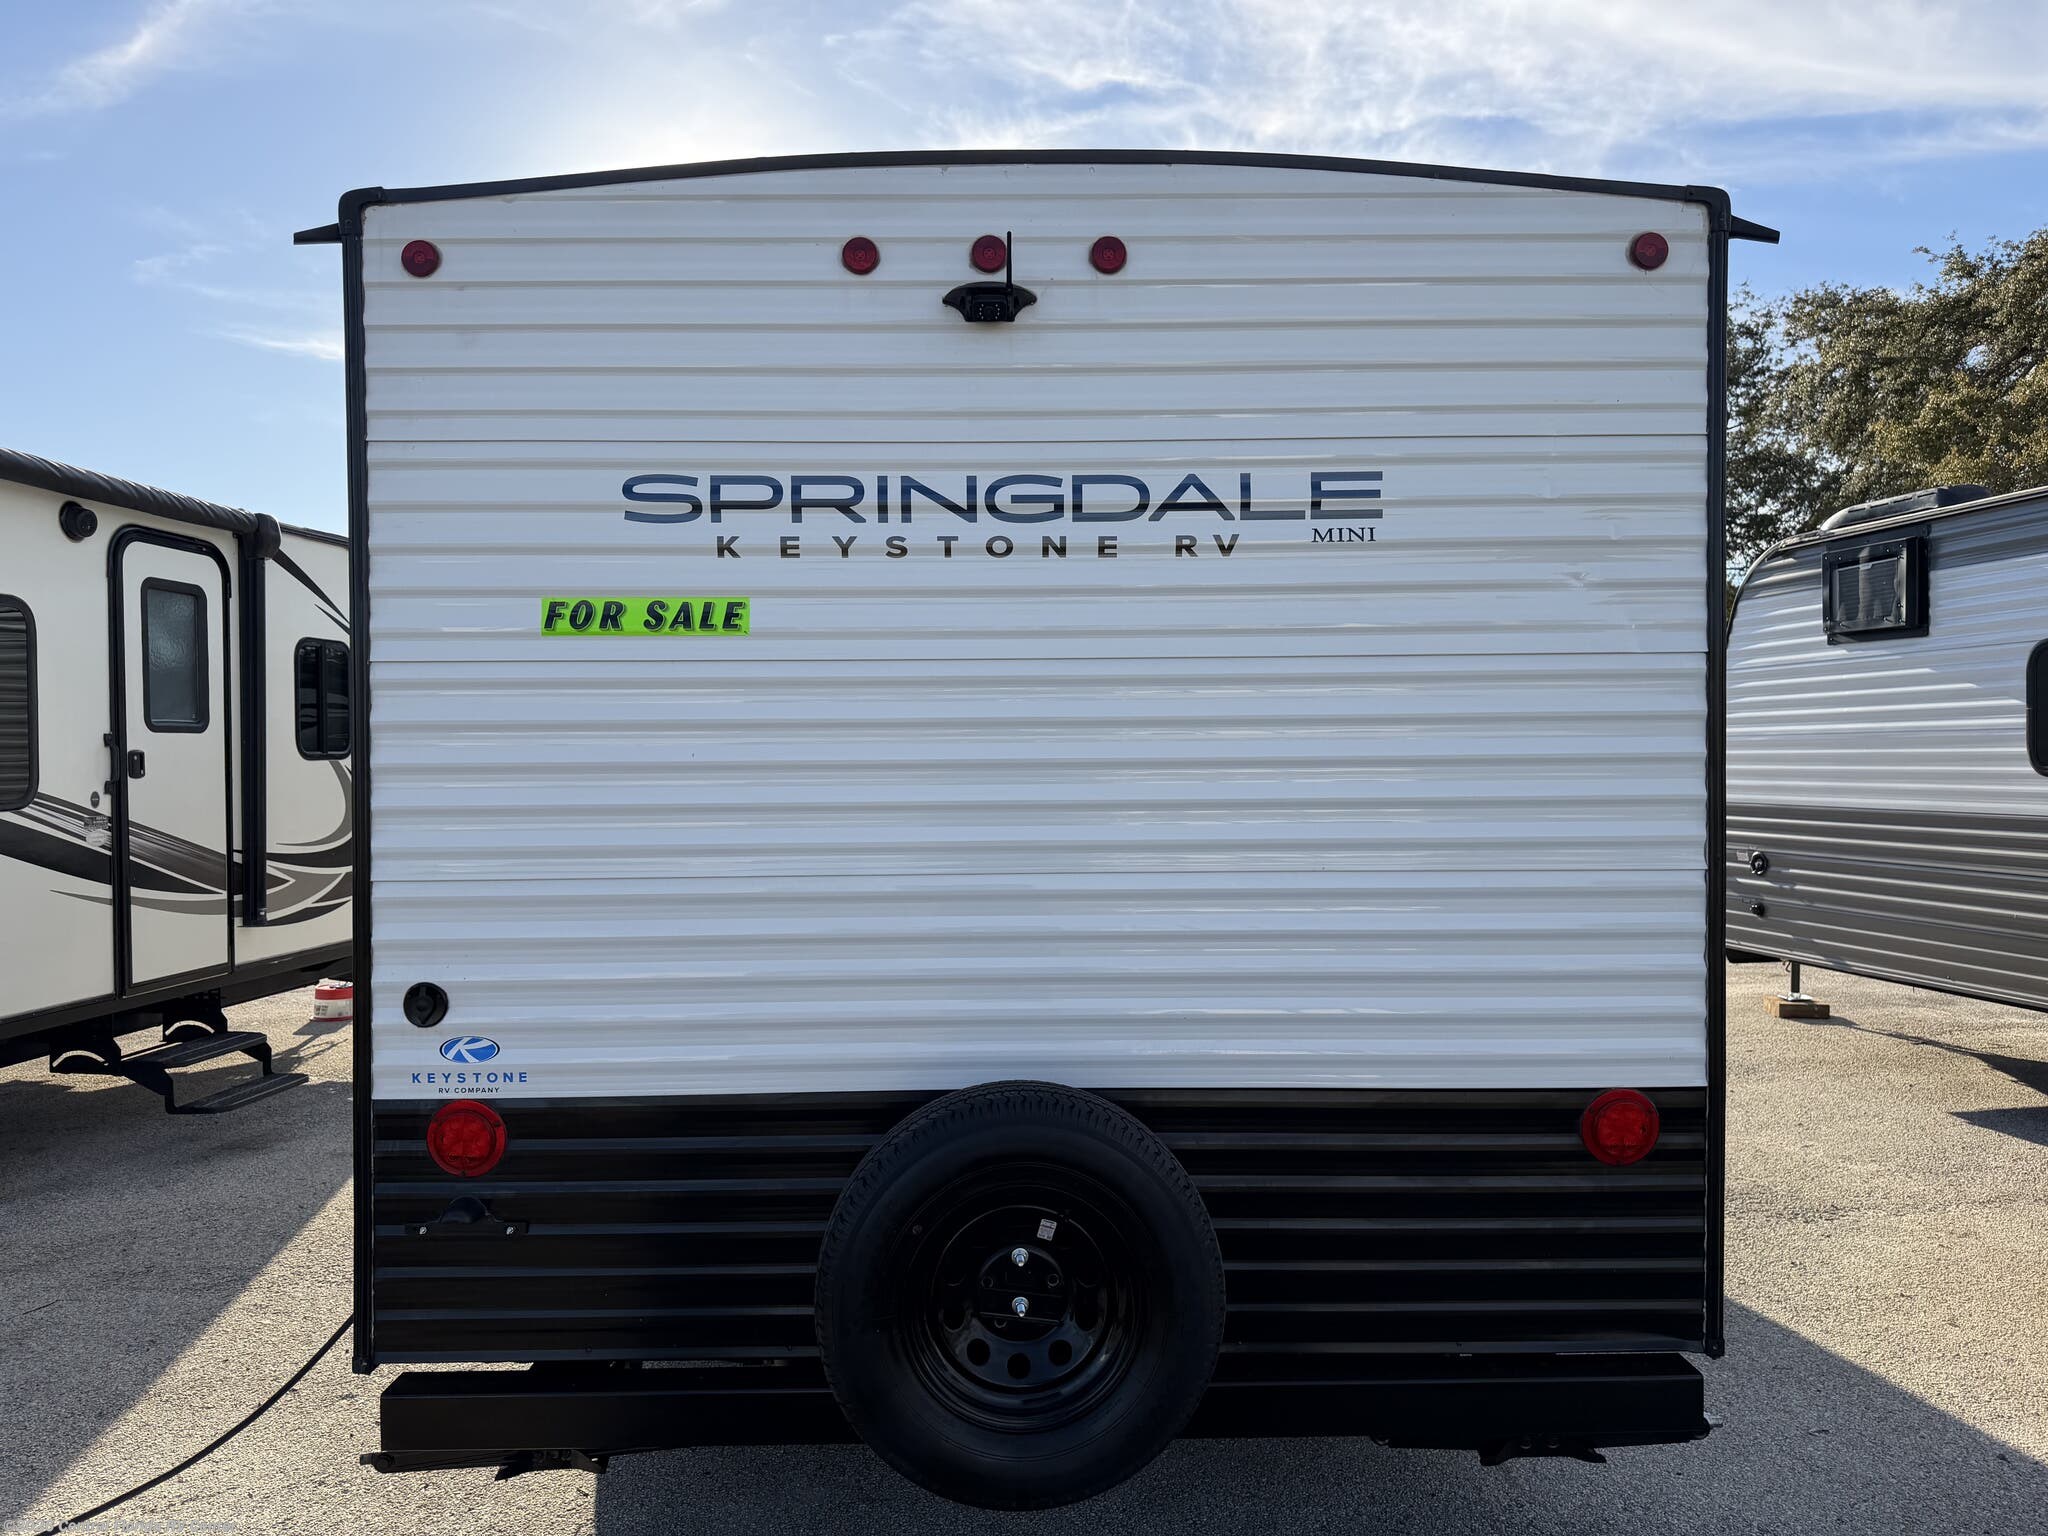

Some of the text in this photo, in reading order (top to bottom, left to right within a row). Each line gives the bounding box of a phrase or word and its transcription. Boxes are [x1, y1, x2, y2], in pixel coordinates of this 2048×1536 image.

[621, 470, 1384, 524] SPRINGDALE
[1311, 526, 1377, 543] MINI
[716, 533, 1241, 559] KEYSTONE RV
[543, 600, 746, 631] FOR SALE
[411, 1071, 528, 1084] KEYSTONE
[438, 1086, 500, 1094] RV COMPANY
